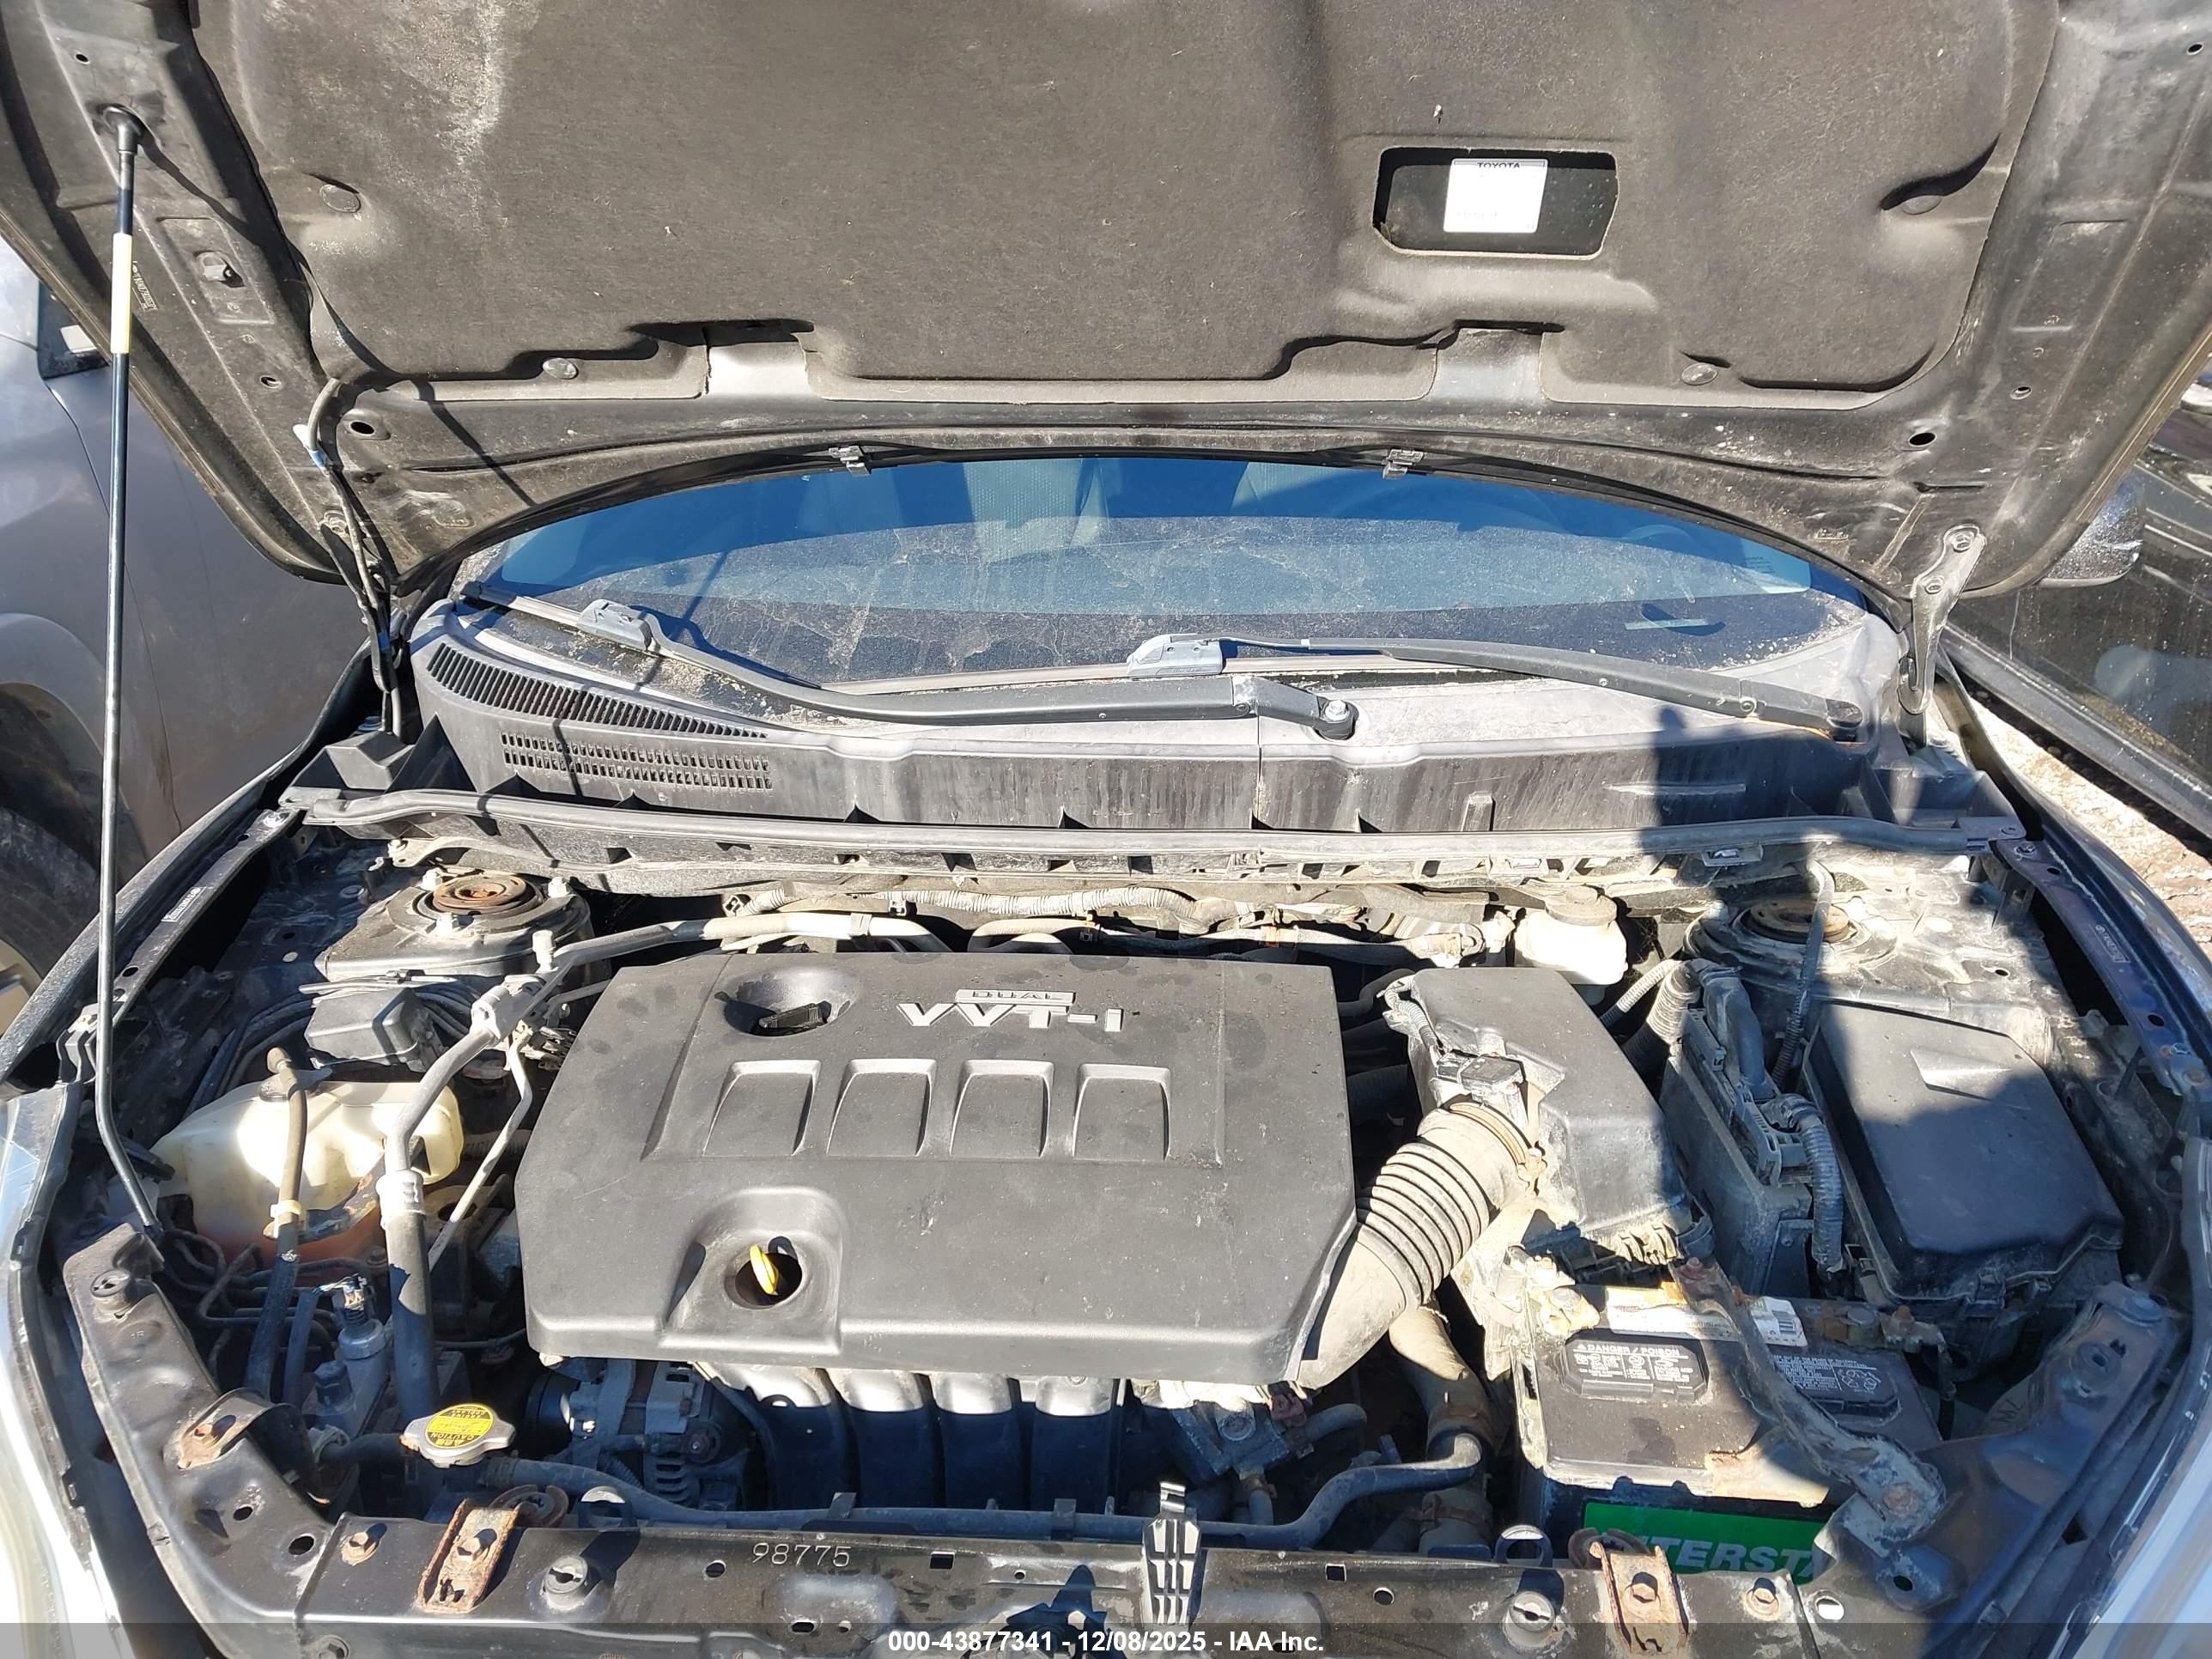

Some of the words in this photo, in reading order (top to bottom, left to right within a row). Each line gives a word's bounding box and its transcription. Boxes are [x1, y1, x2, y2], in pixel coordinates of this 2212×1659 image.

[972, 991, 1063, 1000] DUAL
[1588, 1344, 1630, 1354] DANGER
[1640, 1347, 1680, 1356] POISON
[752, 1542, 852, 1567] 98775
